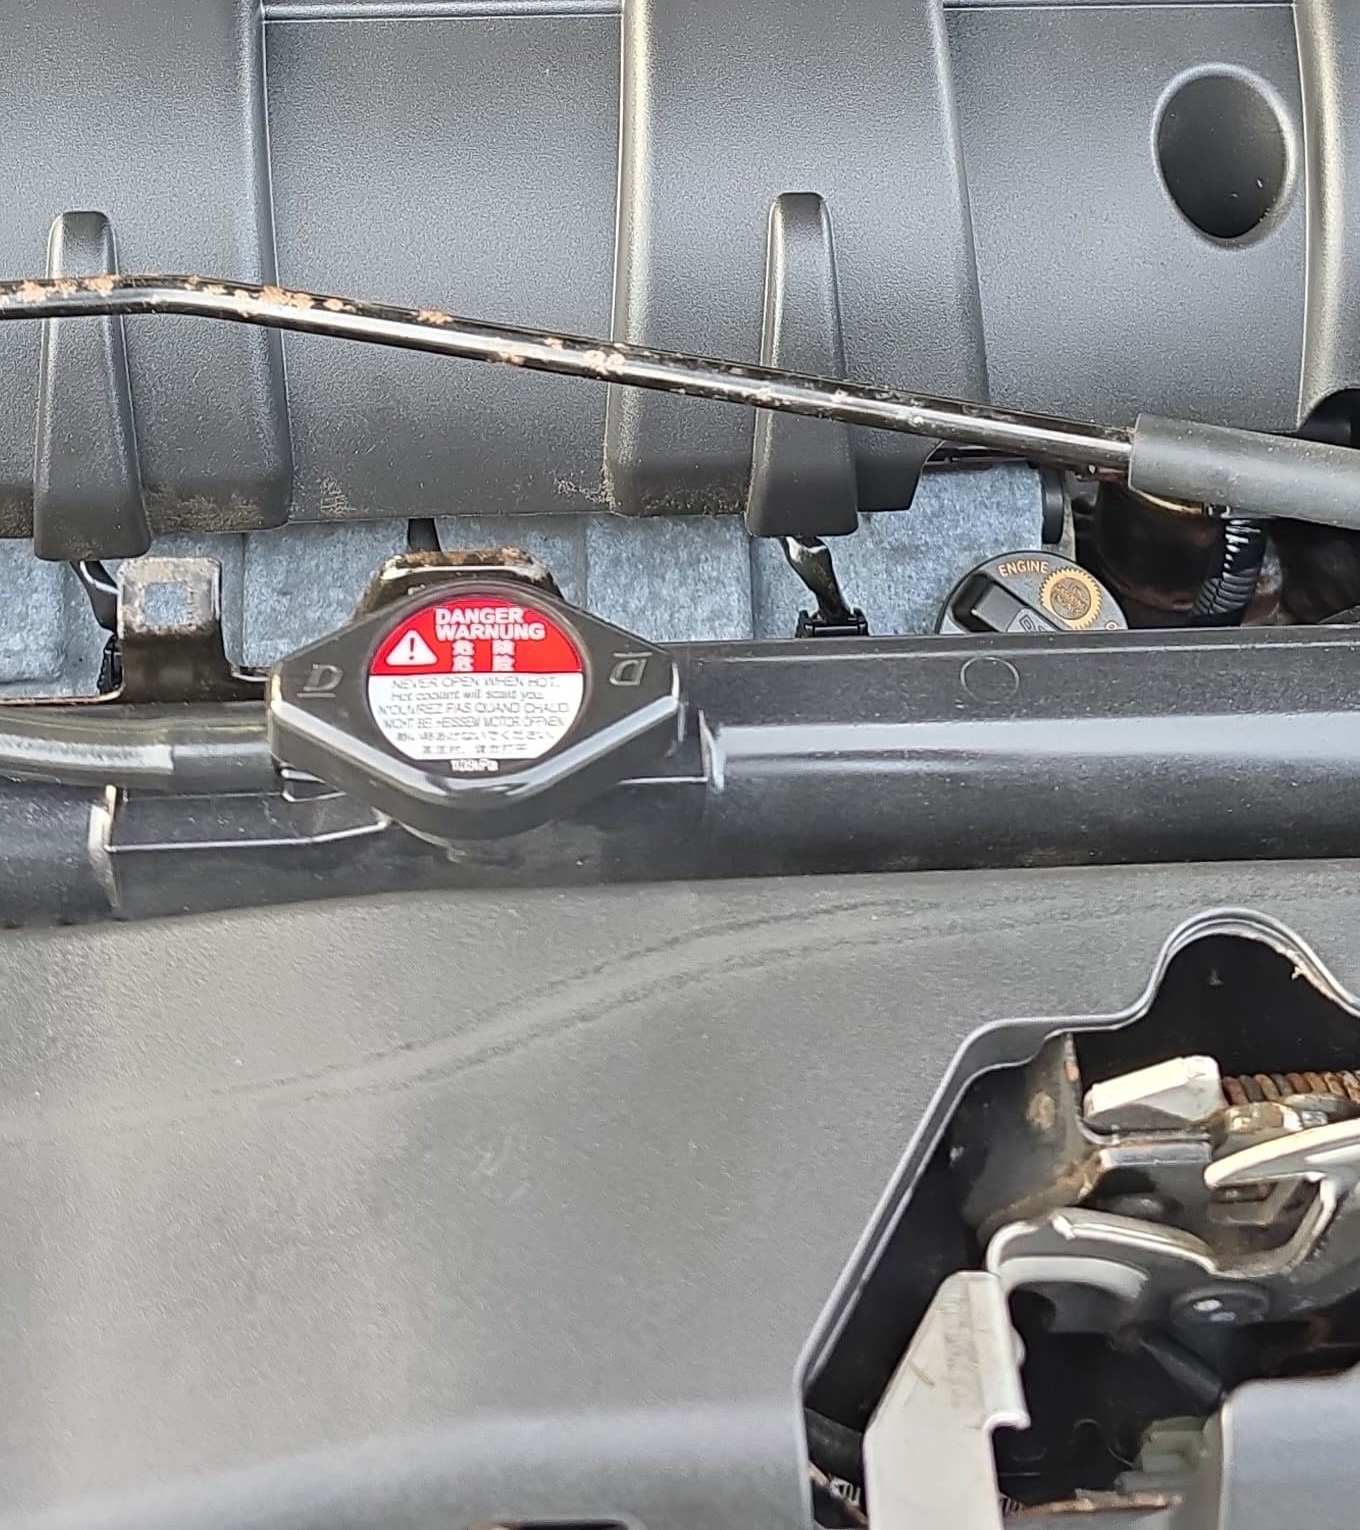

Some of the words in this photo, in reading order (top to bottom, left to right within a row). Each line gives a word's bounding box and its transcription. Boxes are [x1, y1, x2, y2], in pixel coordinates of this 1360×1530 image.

[998, 559, 1049, 577] ENGINE
[435, 607, 525, 624] DANGER
[435, 623, 547, 641] WARNUNG
